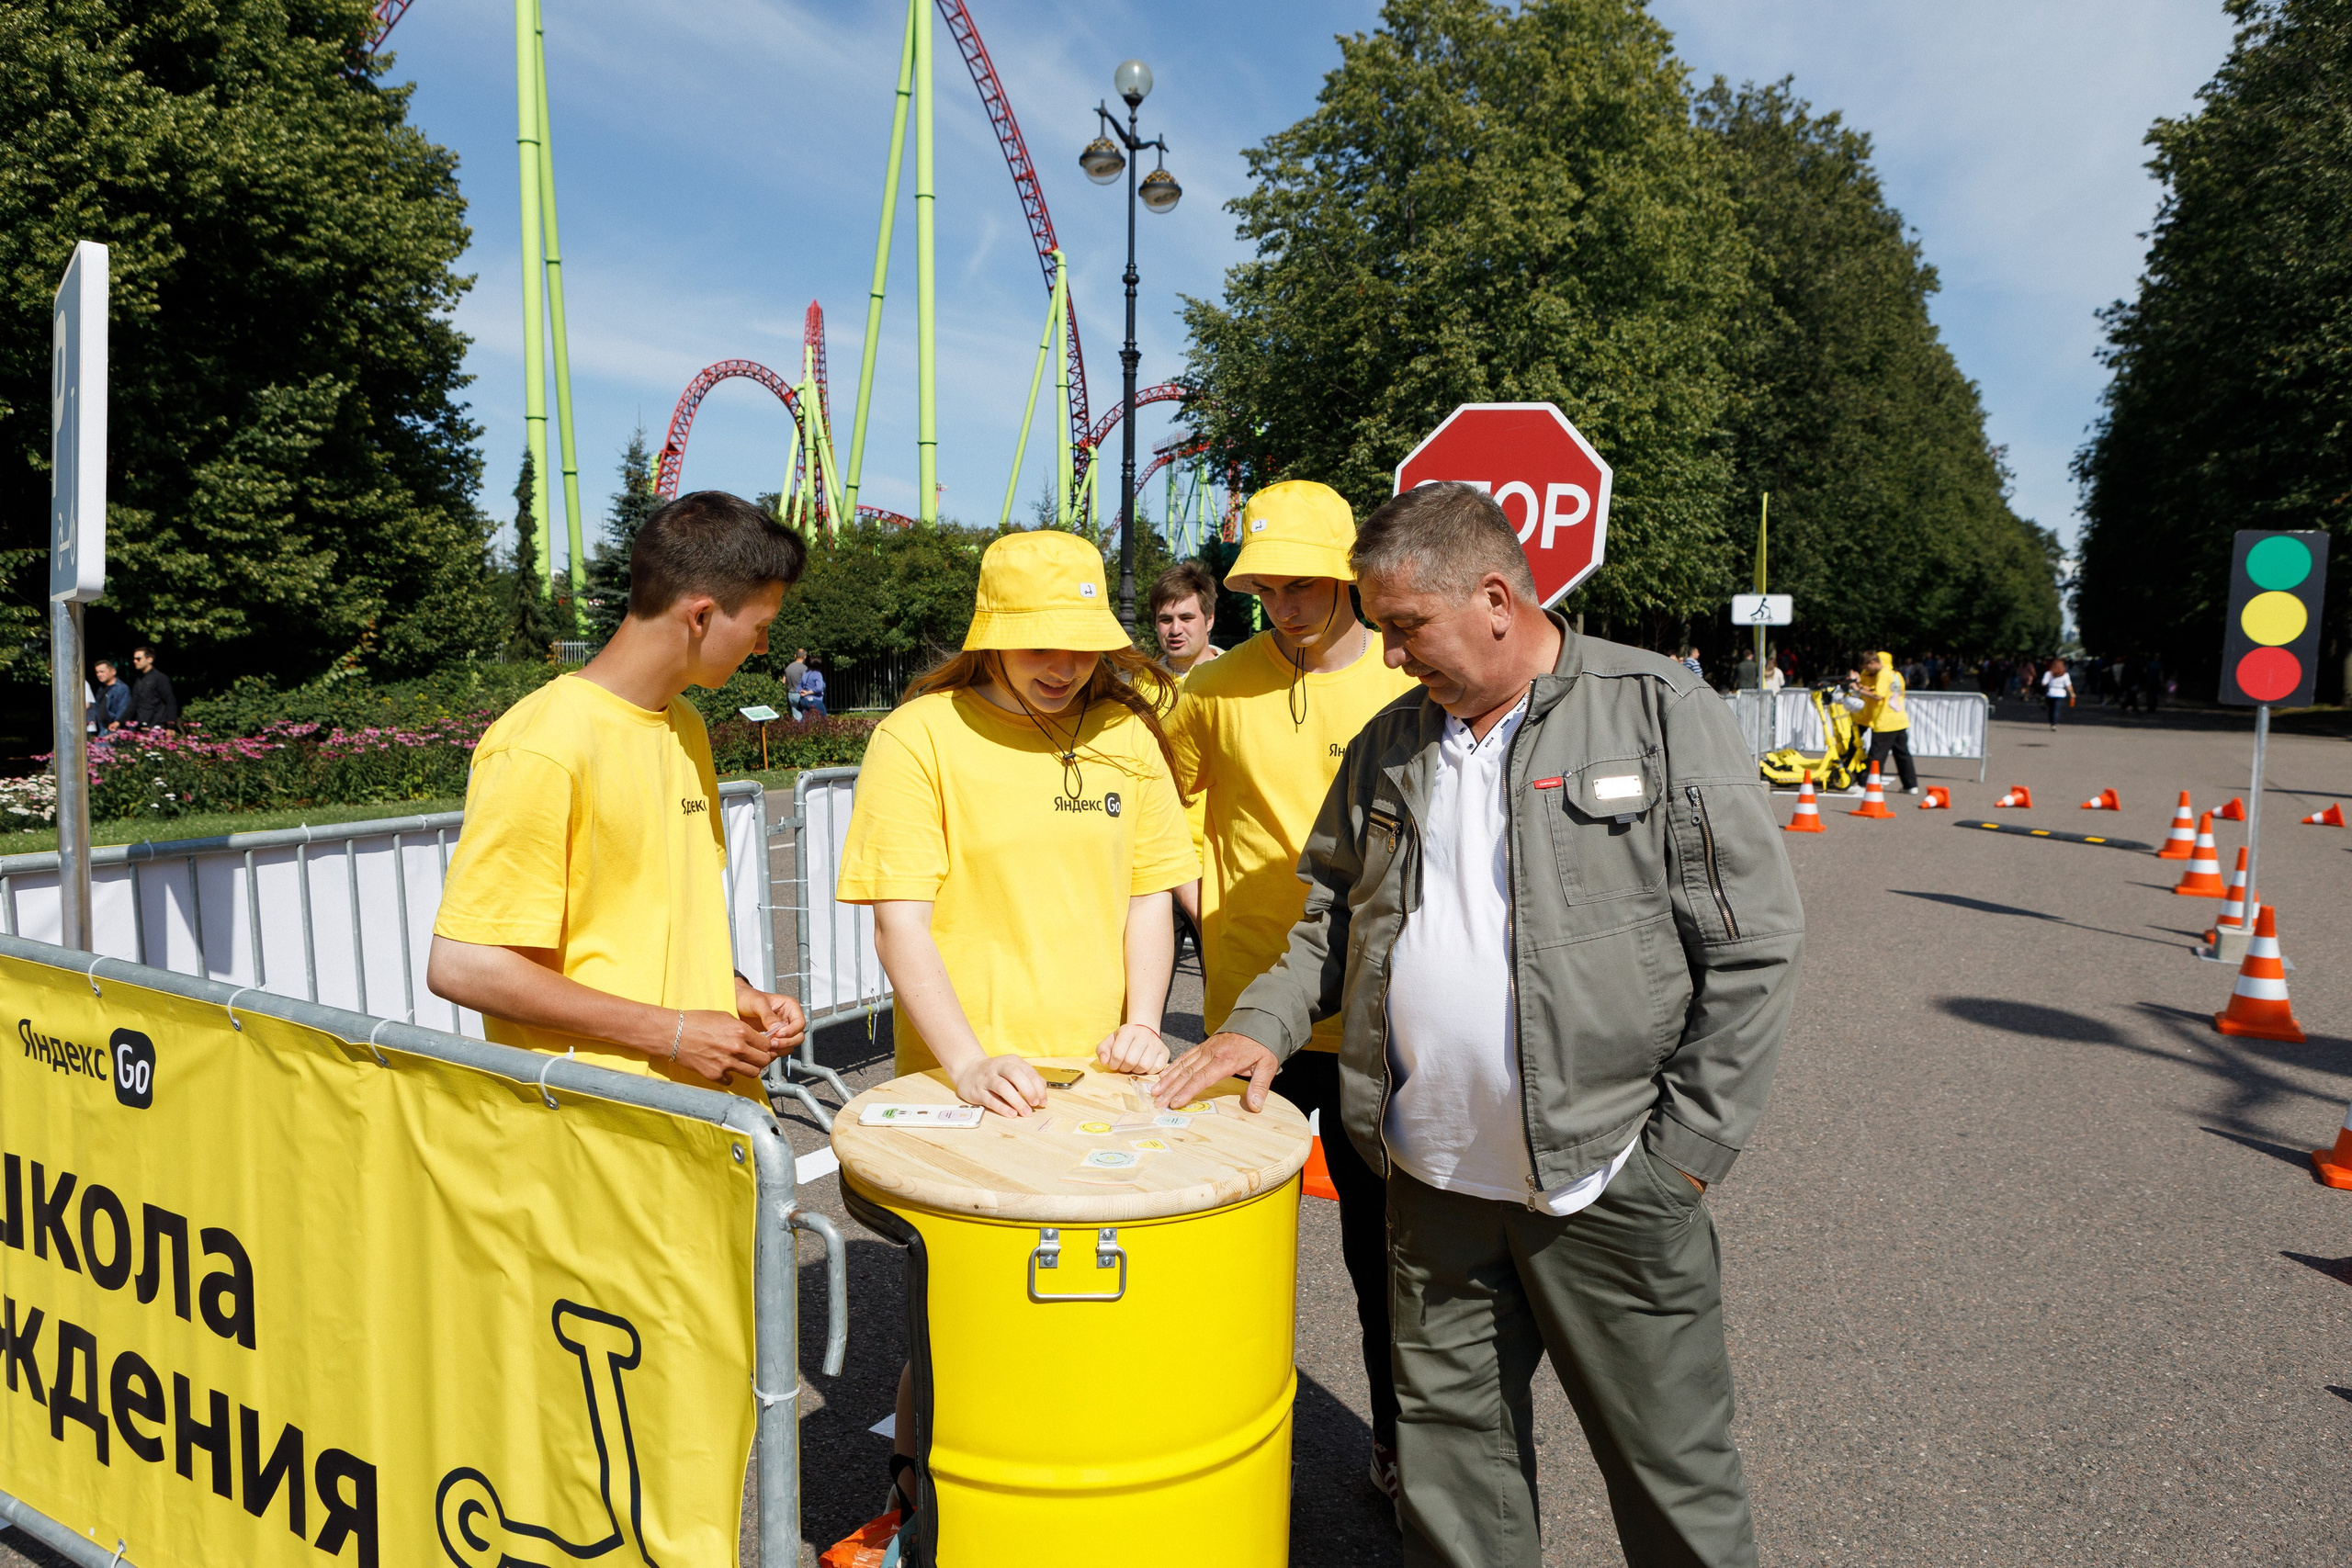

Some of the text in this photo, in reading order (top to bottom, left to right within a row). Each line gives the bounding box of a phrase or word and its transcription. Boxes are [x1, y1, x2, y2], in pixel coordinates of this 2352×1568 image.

[1414, 479, 1591, 549] OP
[1054, 796, 1121, 813] Яндекс Go
[18, 1019, 150, 1095] Яндекс Go
